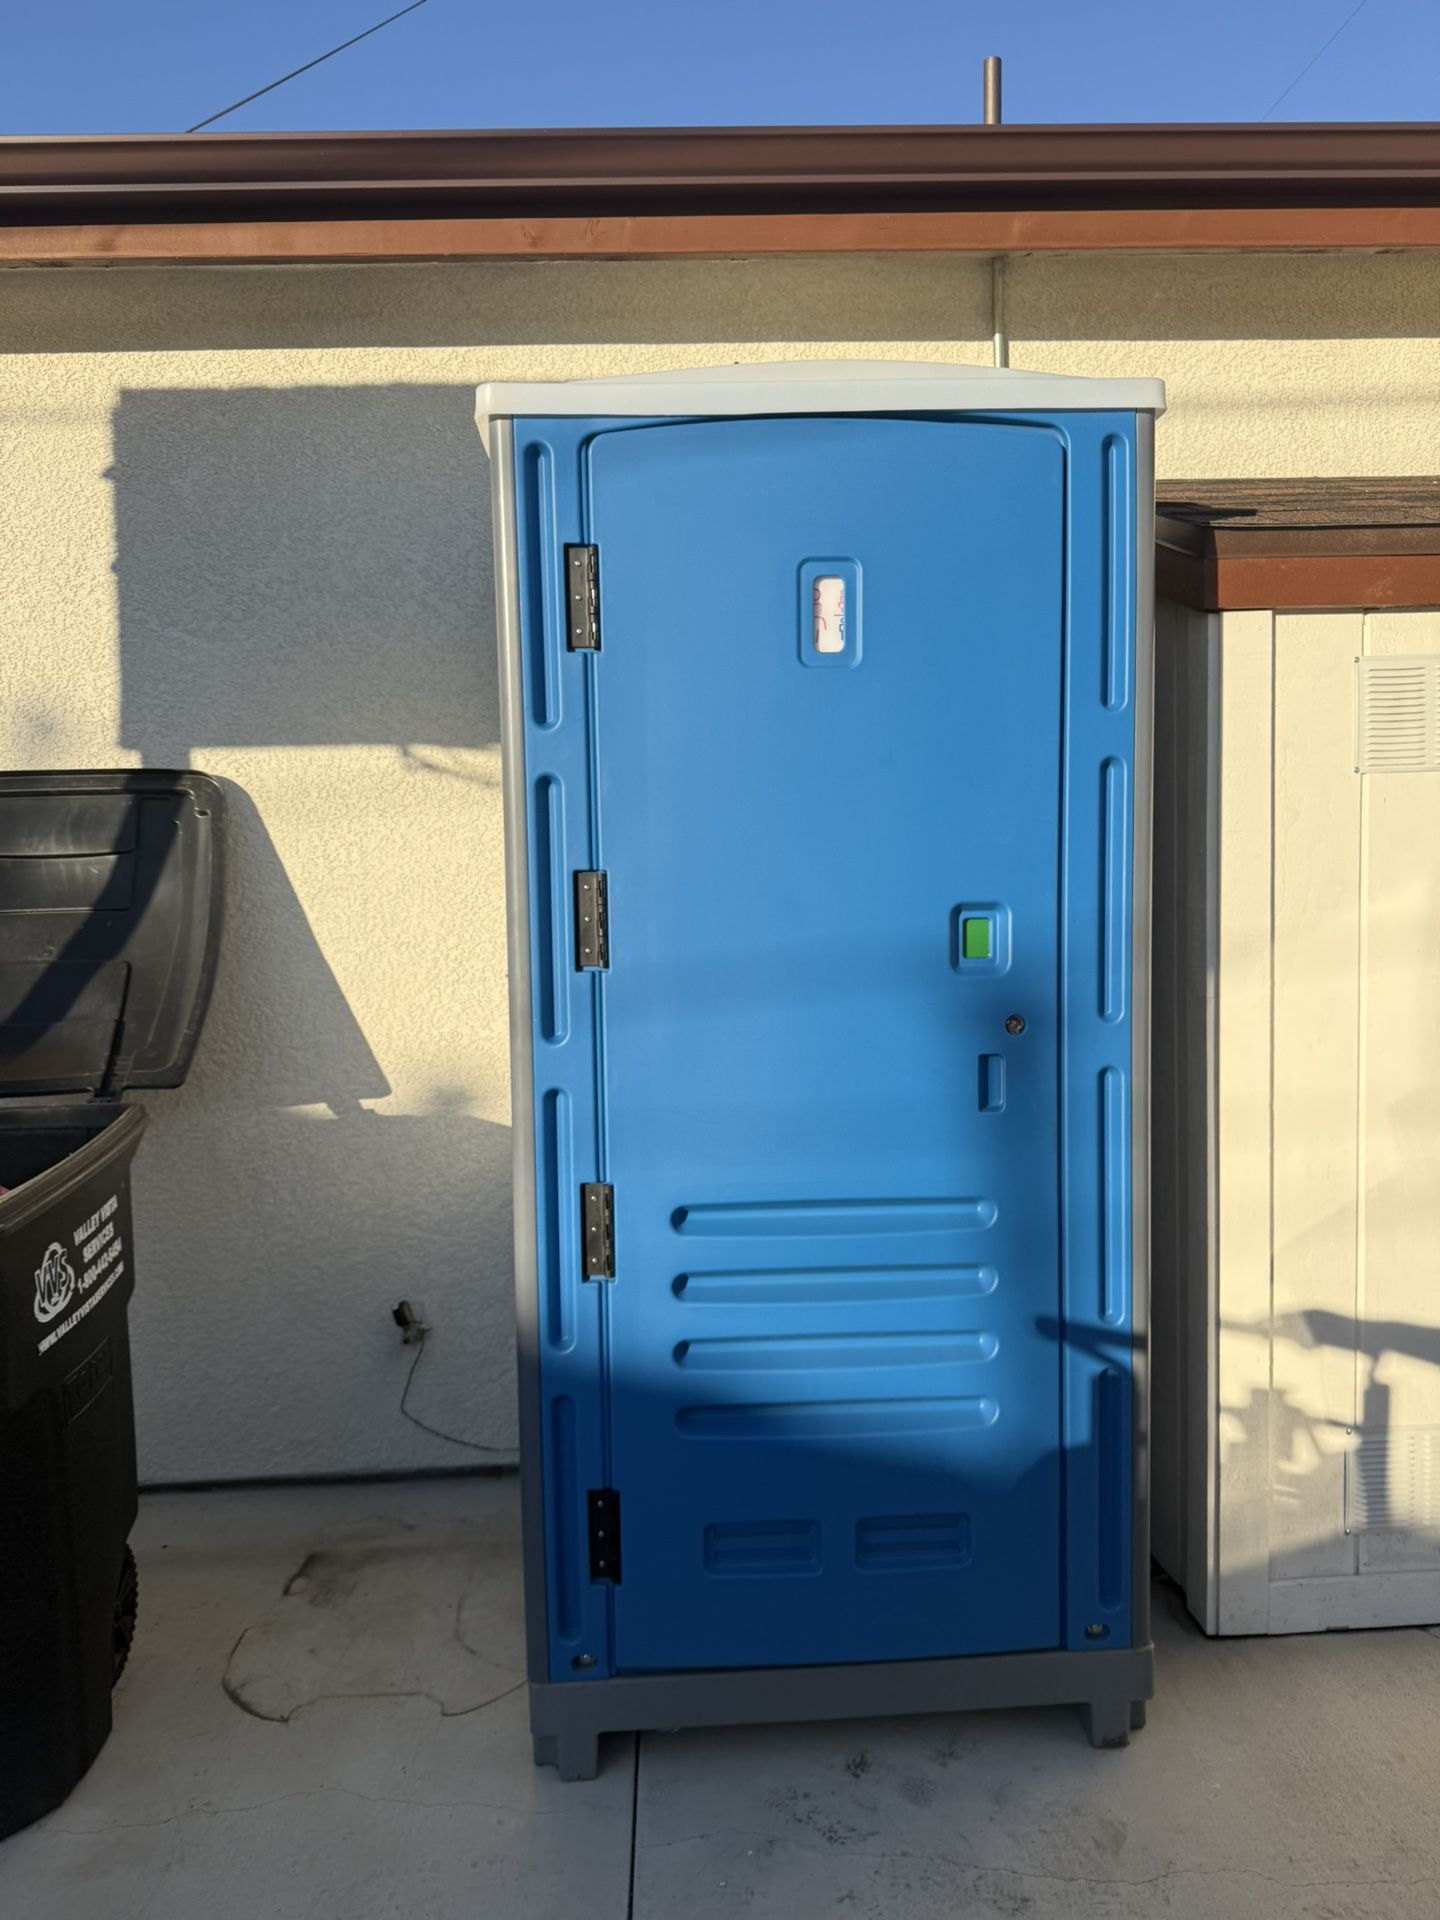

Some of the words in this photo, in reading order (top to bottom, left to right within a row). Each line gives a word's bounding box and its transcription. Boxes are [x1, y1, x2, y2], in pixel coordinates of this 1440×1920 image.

[73, 1210, 100, 1246] VALLEY
[101, 1194, 118, 1222] VISTA
[83, 1221, 114, 1263] SERVICES
